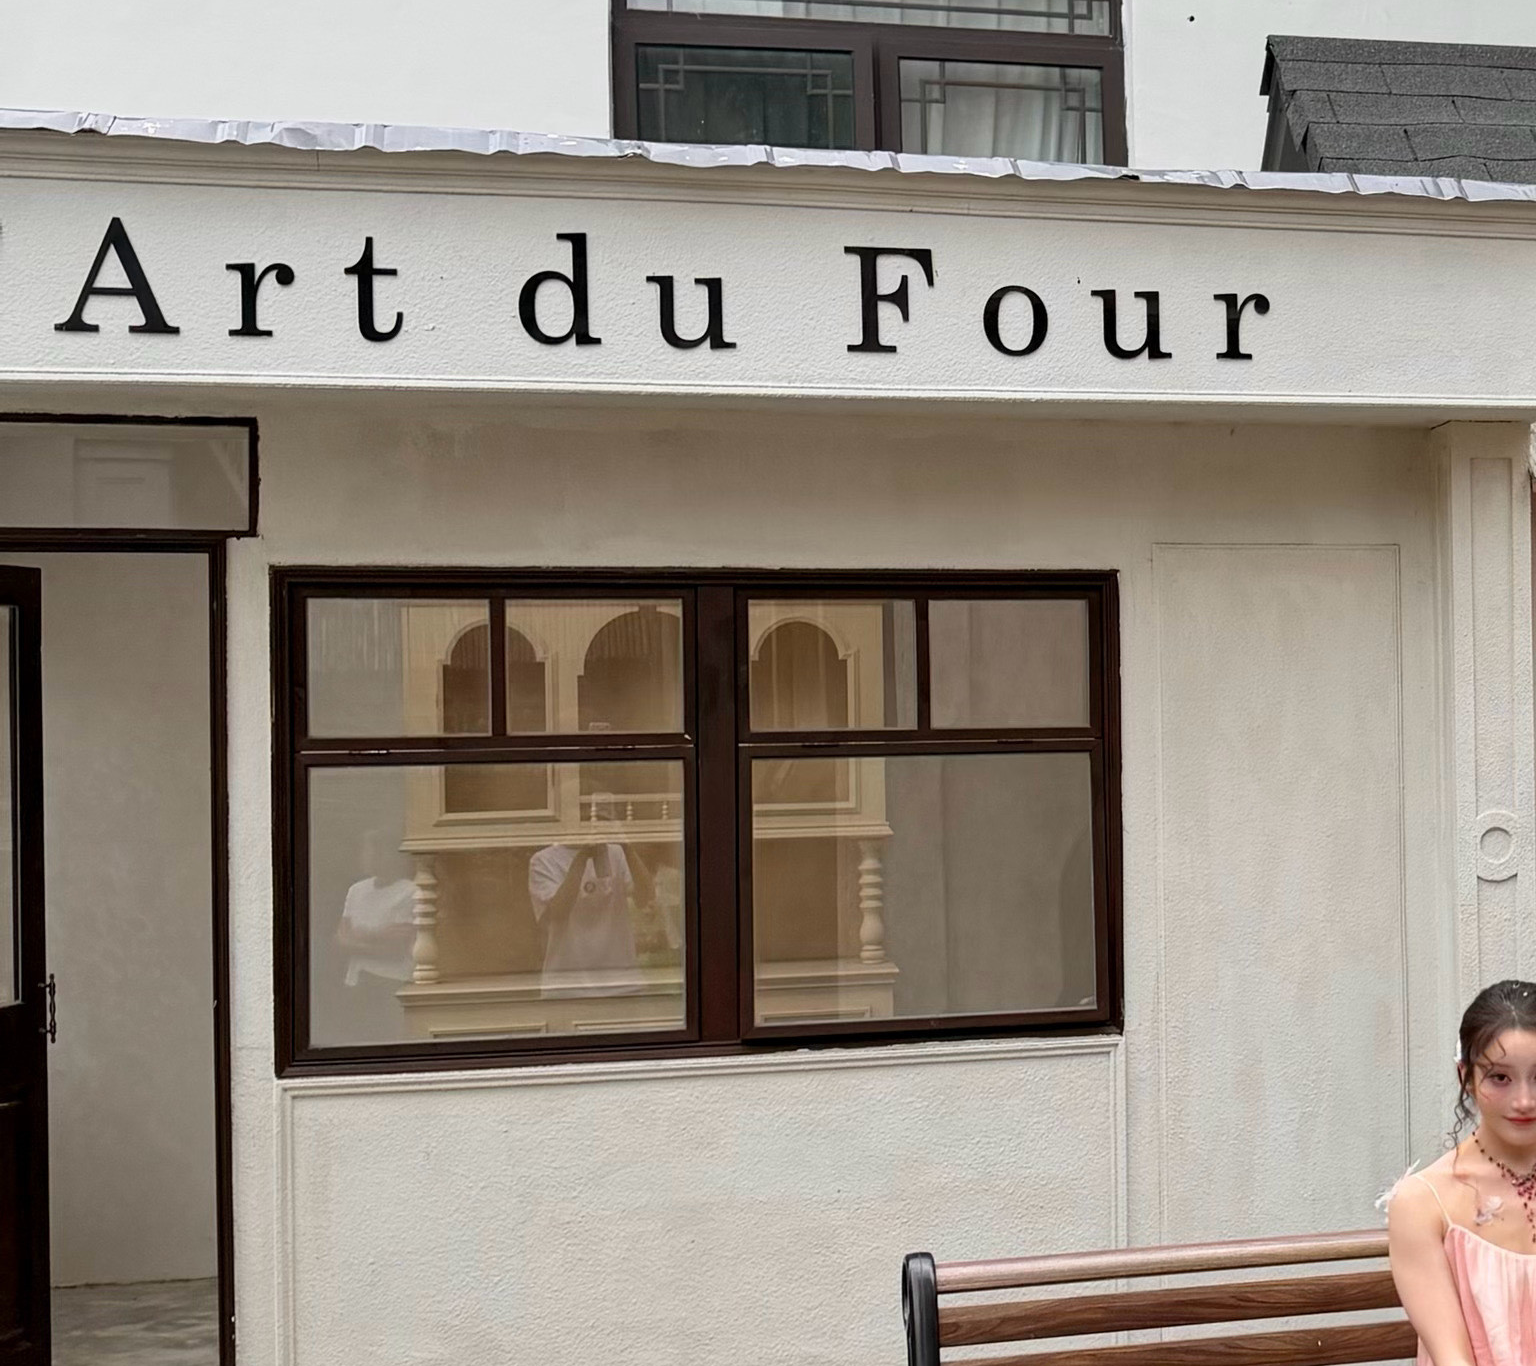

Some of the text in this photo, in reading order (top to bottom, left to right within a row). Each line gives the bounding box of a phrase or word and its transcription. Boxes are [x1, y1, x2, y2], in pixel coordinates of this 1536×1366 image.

[54, 217, 1271, 361] Art du Four
